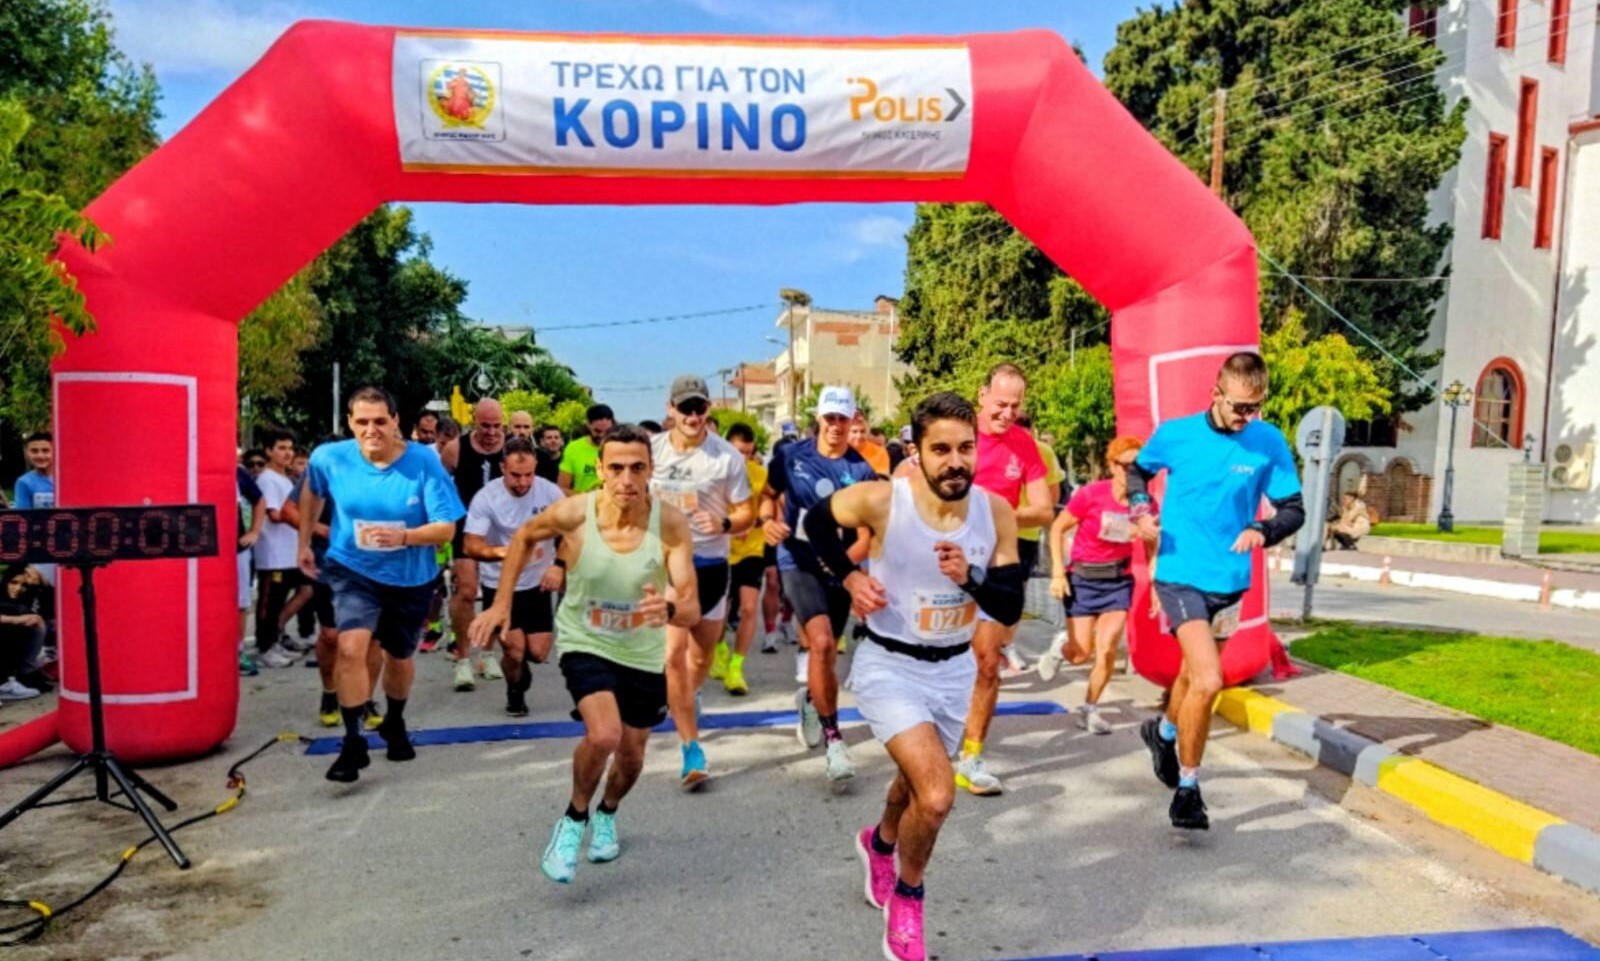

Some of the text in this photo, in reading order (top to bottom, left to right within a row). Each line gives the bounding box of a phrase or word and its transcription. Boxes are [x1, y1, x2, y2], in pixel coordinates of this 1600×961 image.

[551, 61, 805, 94] ΤΡΕΧΩ ΓΙΑ ΤΟΝ
[553, 97, 807, 152] ΚΟΡΙΝΟ
[932, 607, 966, 630] 027
